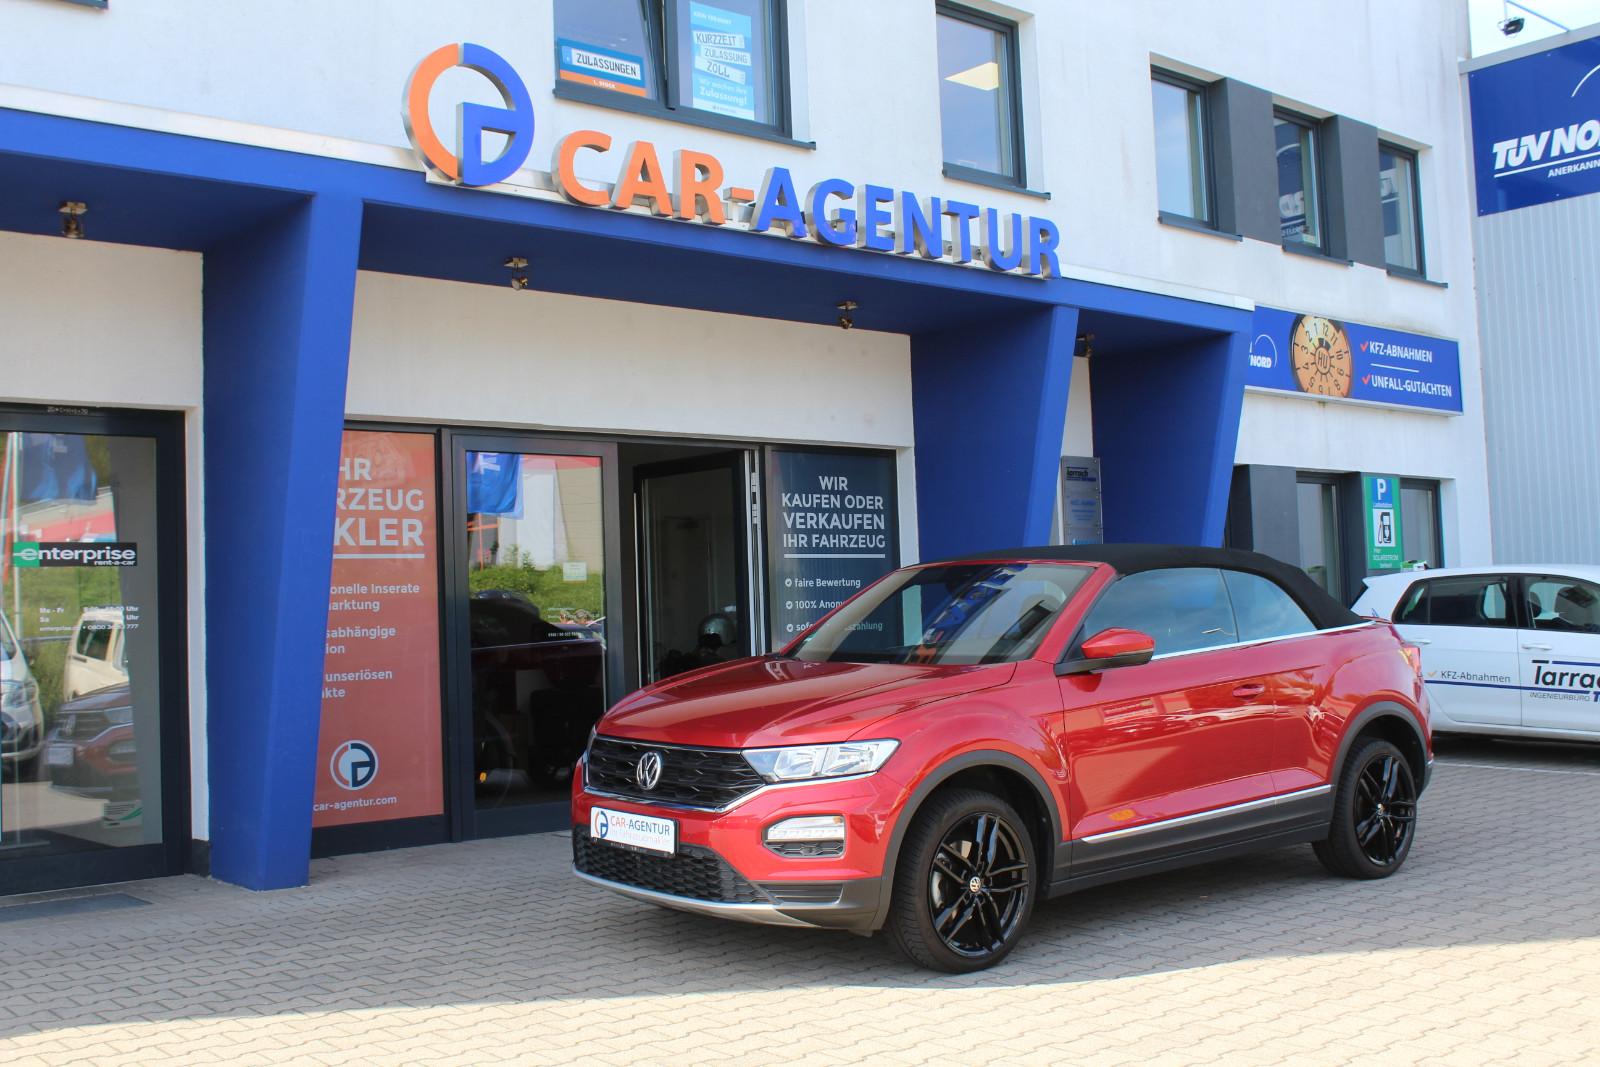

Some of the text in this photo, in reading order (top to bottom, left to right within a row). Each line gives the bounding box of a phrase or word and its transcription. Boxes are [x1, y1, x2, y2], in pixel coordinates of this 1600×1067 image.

[696, 32, 736, 46] KURZZEIT
[704, 47, 748, 64] ZULASSUNG
[576, 52, 637, 77] ZULASSUNGEN
[706, 61, 730, 78] ZOLL
[1550, 119, 1600, 158] NO
[553, 129, 1061, 279] CAR-AGENTUR
[1369, 340, 1433, 363] KFZ-ABNAHMEN
[1250, 354, 1273, 369] NORD
[1371, 374, 1452, 398] UNFALL-GUTACHTEN
[338, 457, 372, 481] HR
[819, 475, 848, 491] WIR
[1376, 478, 1387, 500] P
[336, 487, 425, 512] RZEUG
[782, 493, 884, 510] KAUFEN ODER
[783, 511, 885, 530] VERKAUFEN
[333, 517, 425, 546] KLER
[783, 533, 886, 549] IHR FAHRZEUG
[13, 546, 136, 564] enterprise
[330, 583, 420, 594] onelle Inserate
[794, 578, 861, 589] faire Bewertung
[328, 600, 381, 613] arktung
[795, 600, 817, 609] 100%
[326, 625, 396, 640] sabhängige
[325, 643, 346, 655] ion
[325, 668, 394, 683] unseriösen
[1440, 670, 1511, 684] KFZ-Abnahmen
[321, 687, 347, 700] kte
[1530, 692, 1590, 701] INGENIEURBÜRO
[312, 796, 398, 812] car-agentur.com
[610, 816, 670, 836] CAR-AGENTUR
